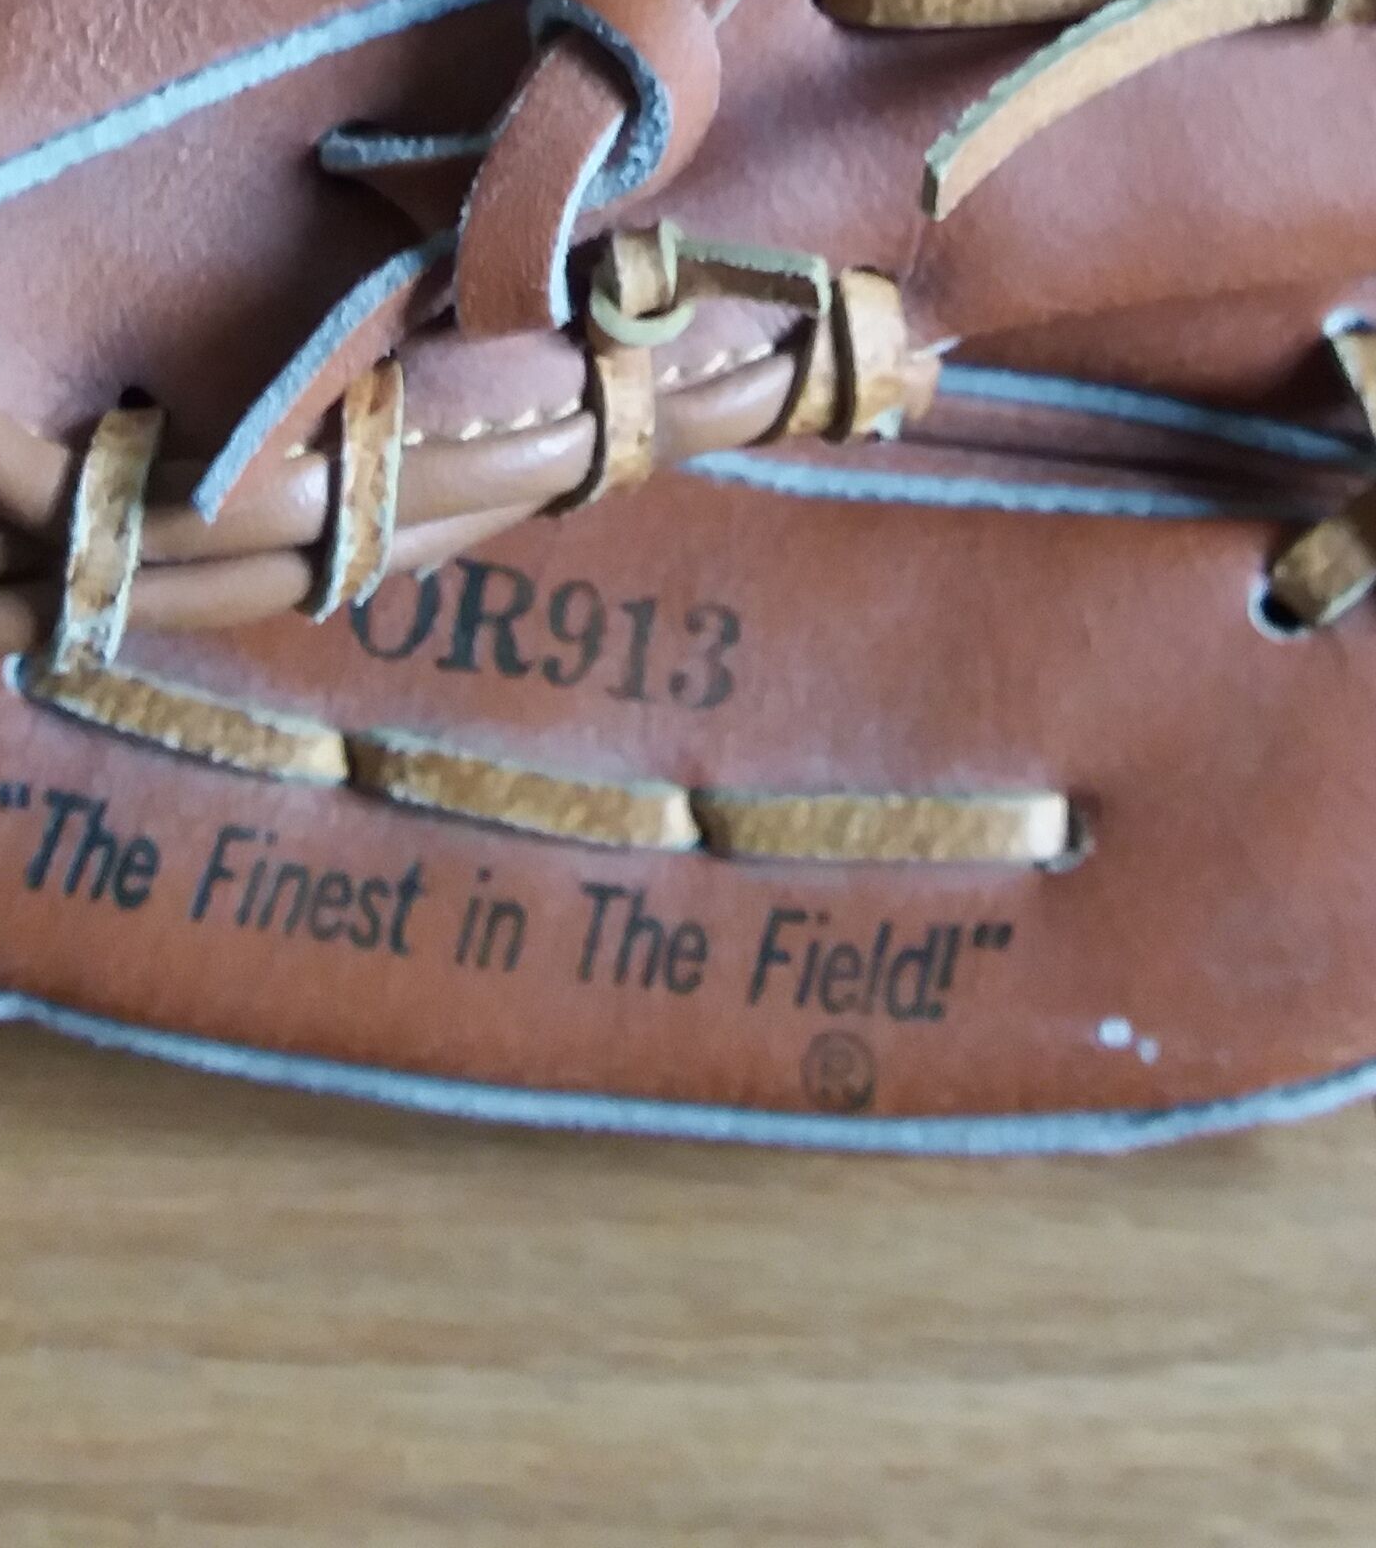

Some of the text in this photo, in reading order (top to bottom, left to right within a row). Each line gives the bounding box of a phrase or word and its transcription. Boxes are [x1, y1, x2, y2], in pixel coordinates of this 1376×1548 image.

[190, 826, 424, 956] Finest
[454, 866, 528, 973] in
[577, 880, 709, 996] The
